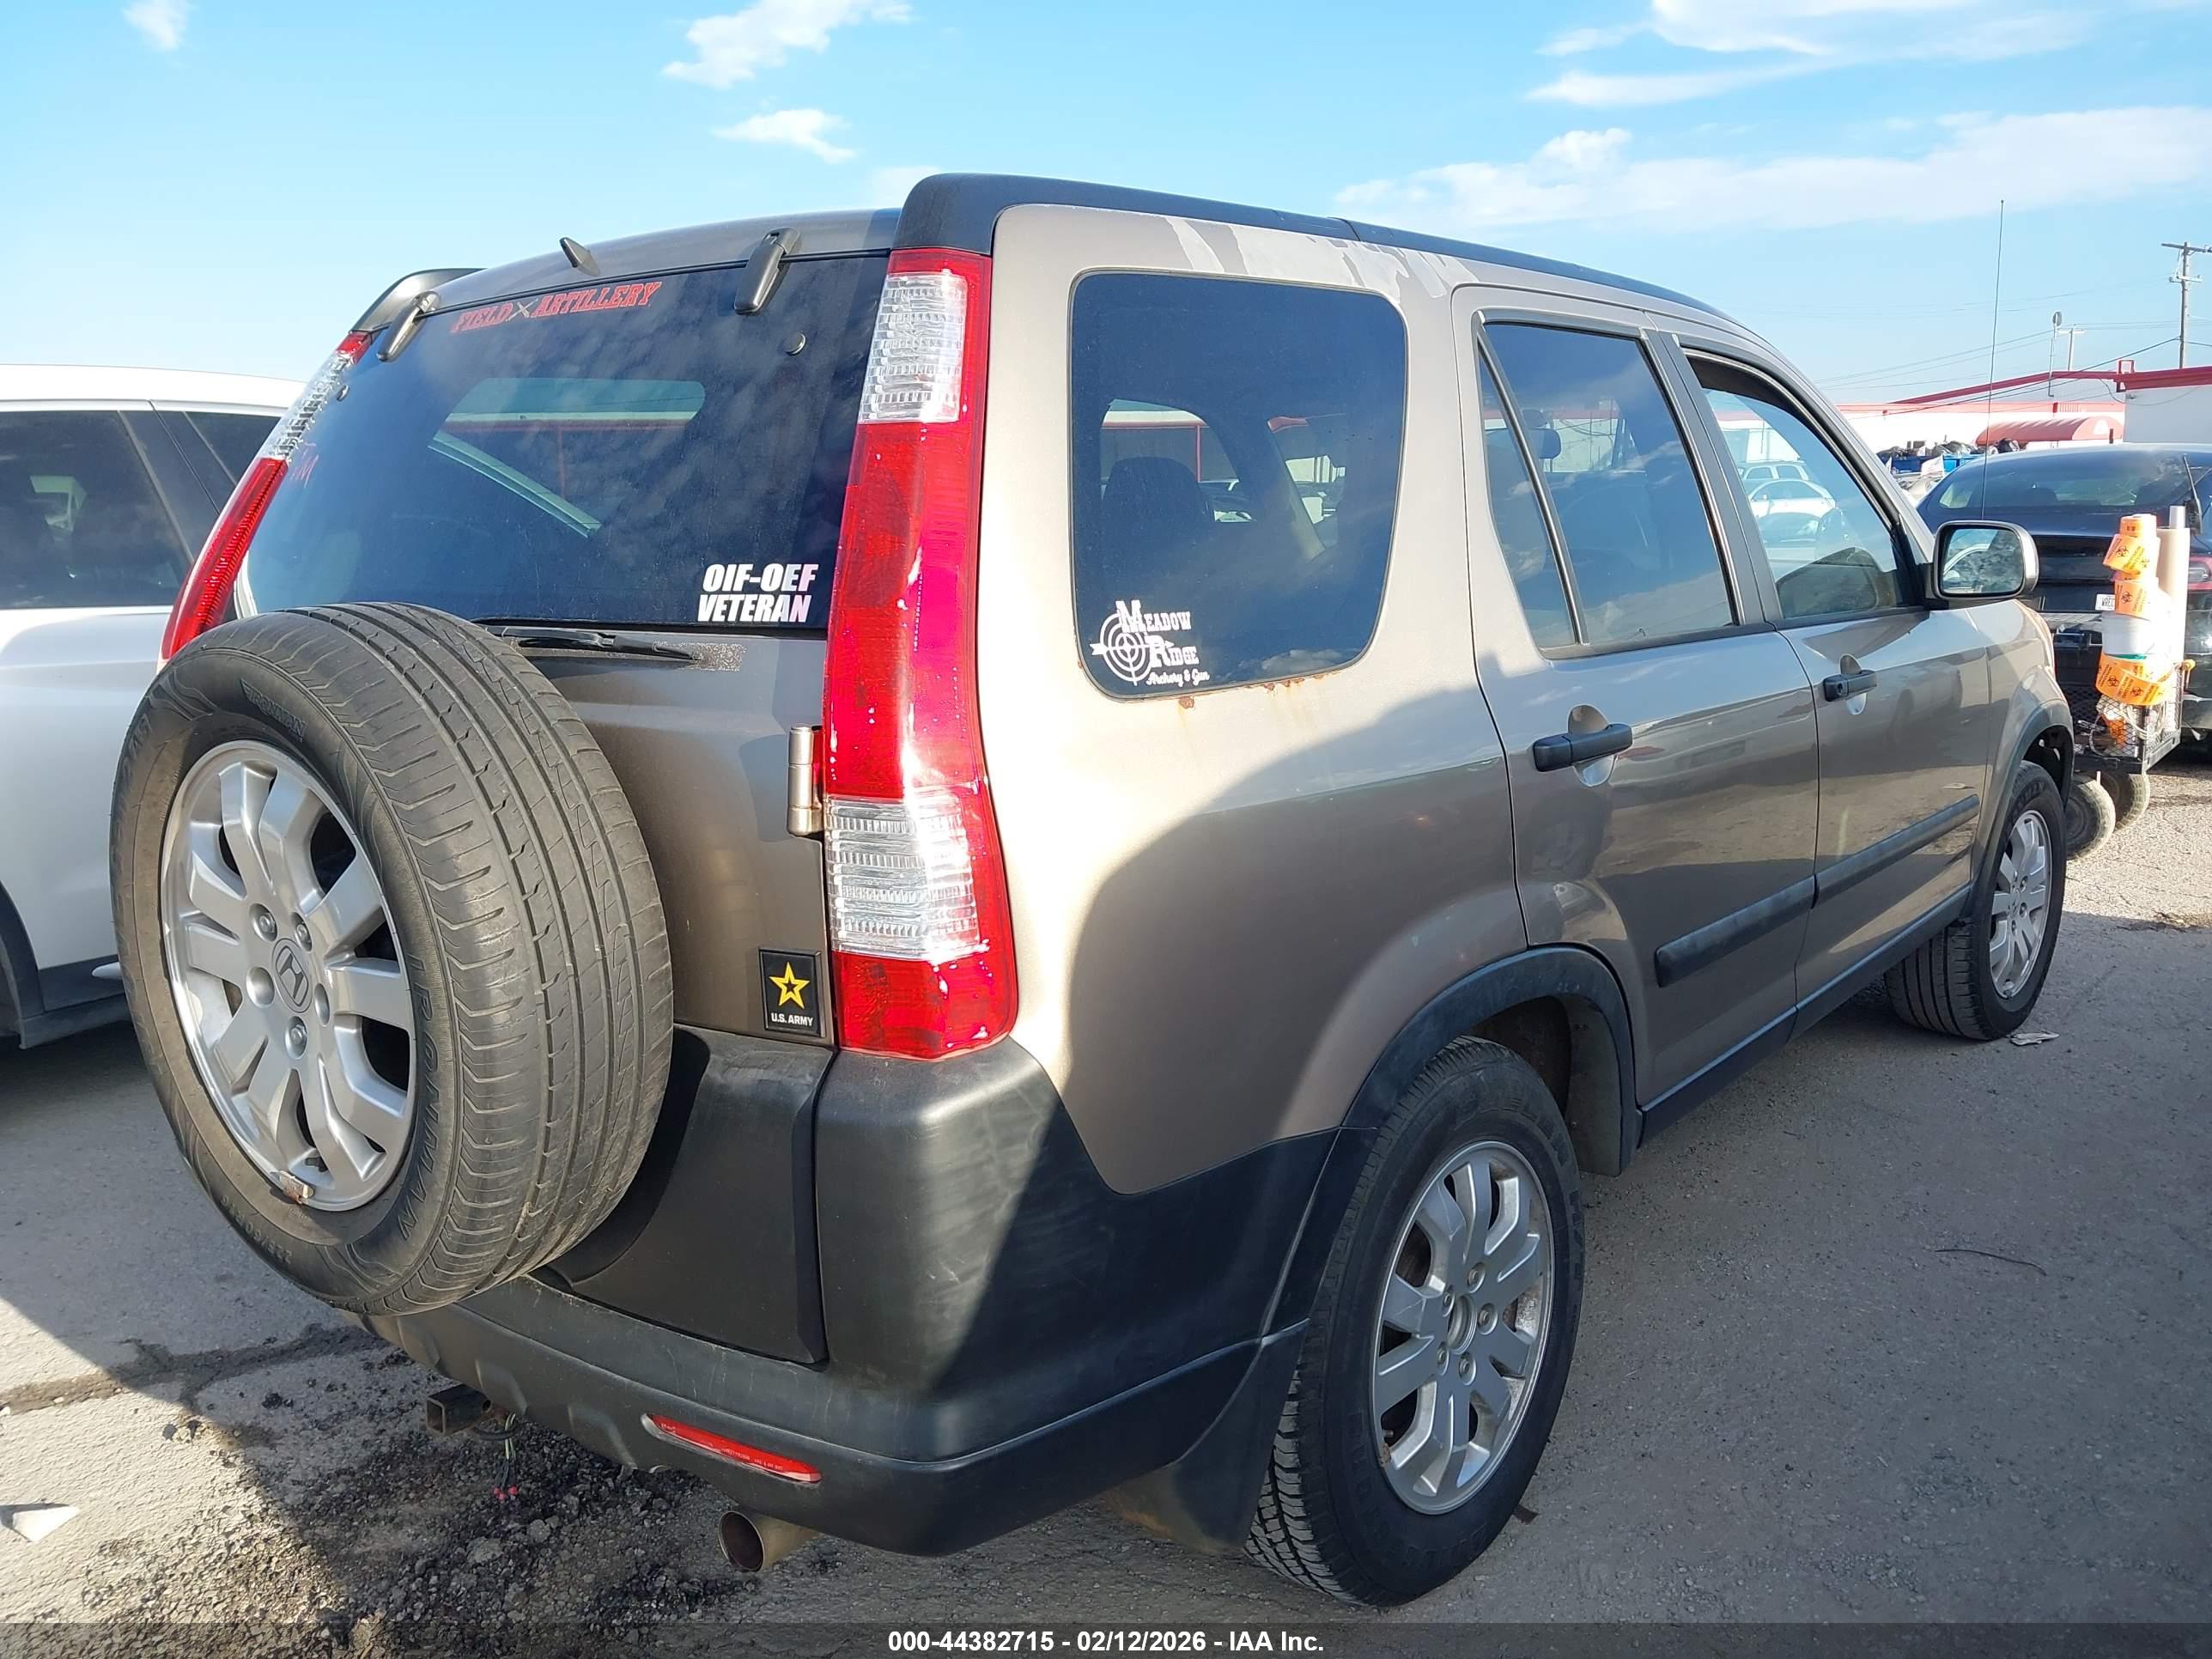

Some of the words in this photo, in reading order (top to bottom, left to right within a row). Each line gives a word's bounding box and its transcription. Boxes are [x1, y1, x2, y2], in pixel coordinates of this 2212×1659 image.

[450, 301, 514, 333] FIELD
[530, 282, 662, 319] ARTILLERY
[702, 563, 819, 592] OIF-OEF
[697, 594, 812, 623] VETERAN
[1146, 672, 1183, 687] Archery
[1183, 668, 1191, 682] &
[1191, 668, 1211, 686] Gun
[771, 1012, 787, 1024] U.S.
[787, 1015, 814, 1027] ARMY
[398, 951, 441, 1242] IRONMAN
